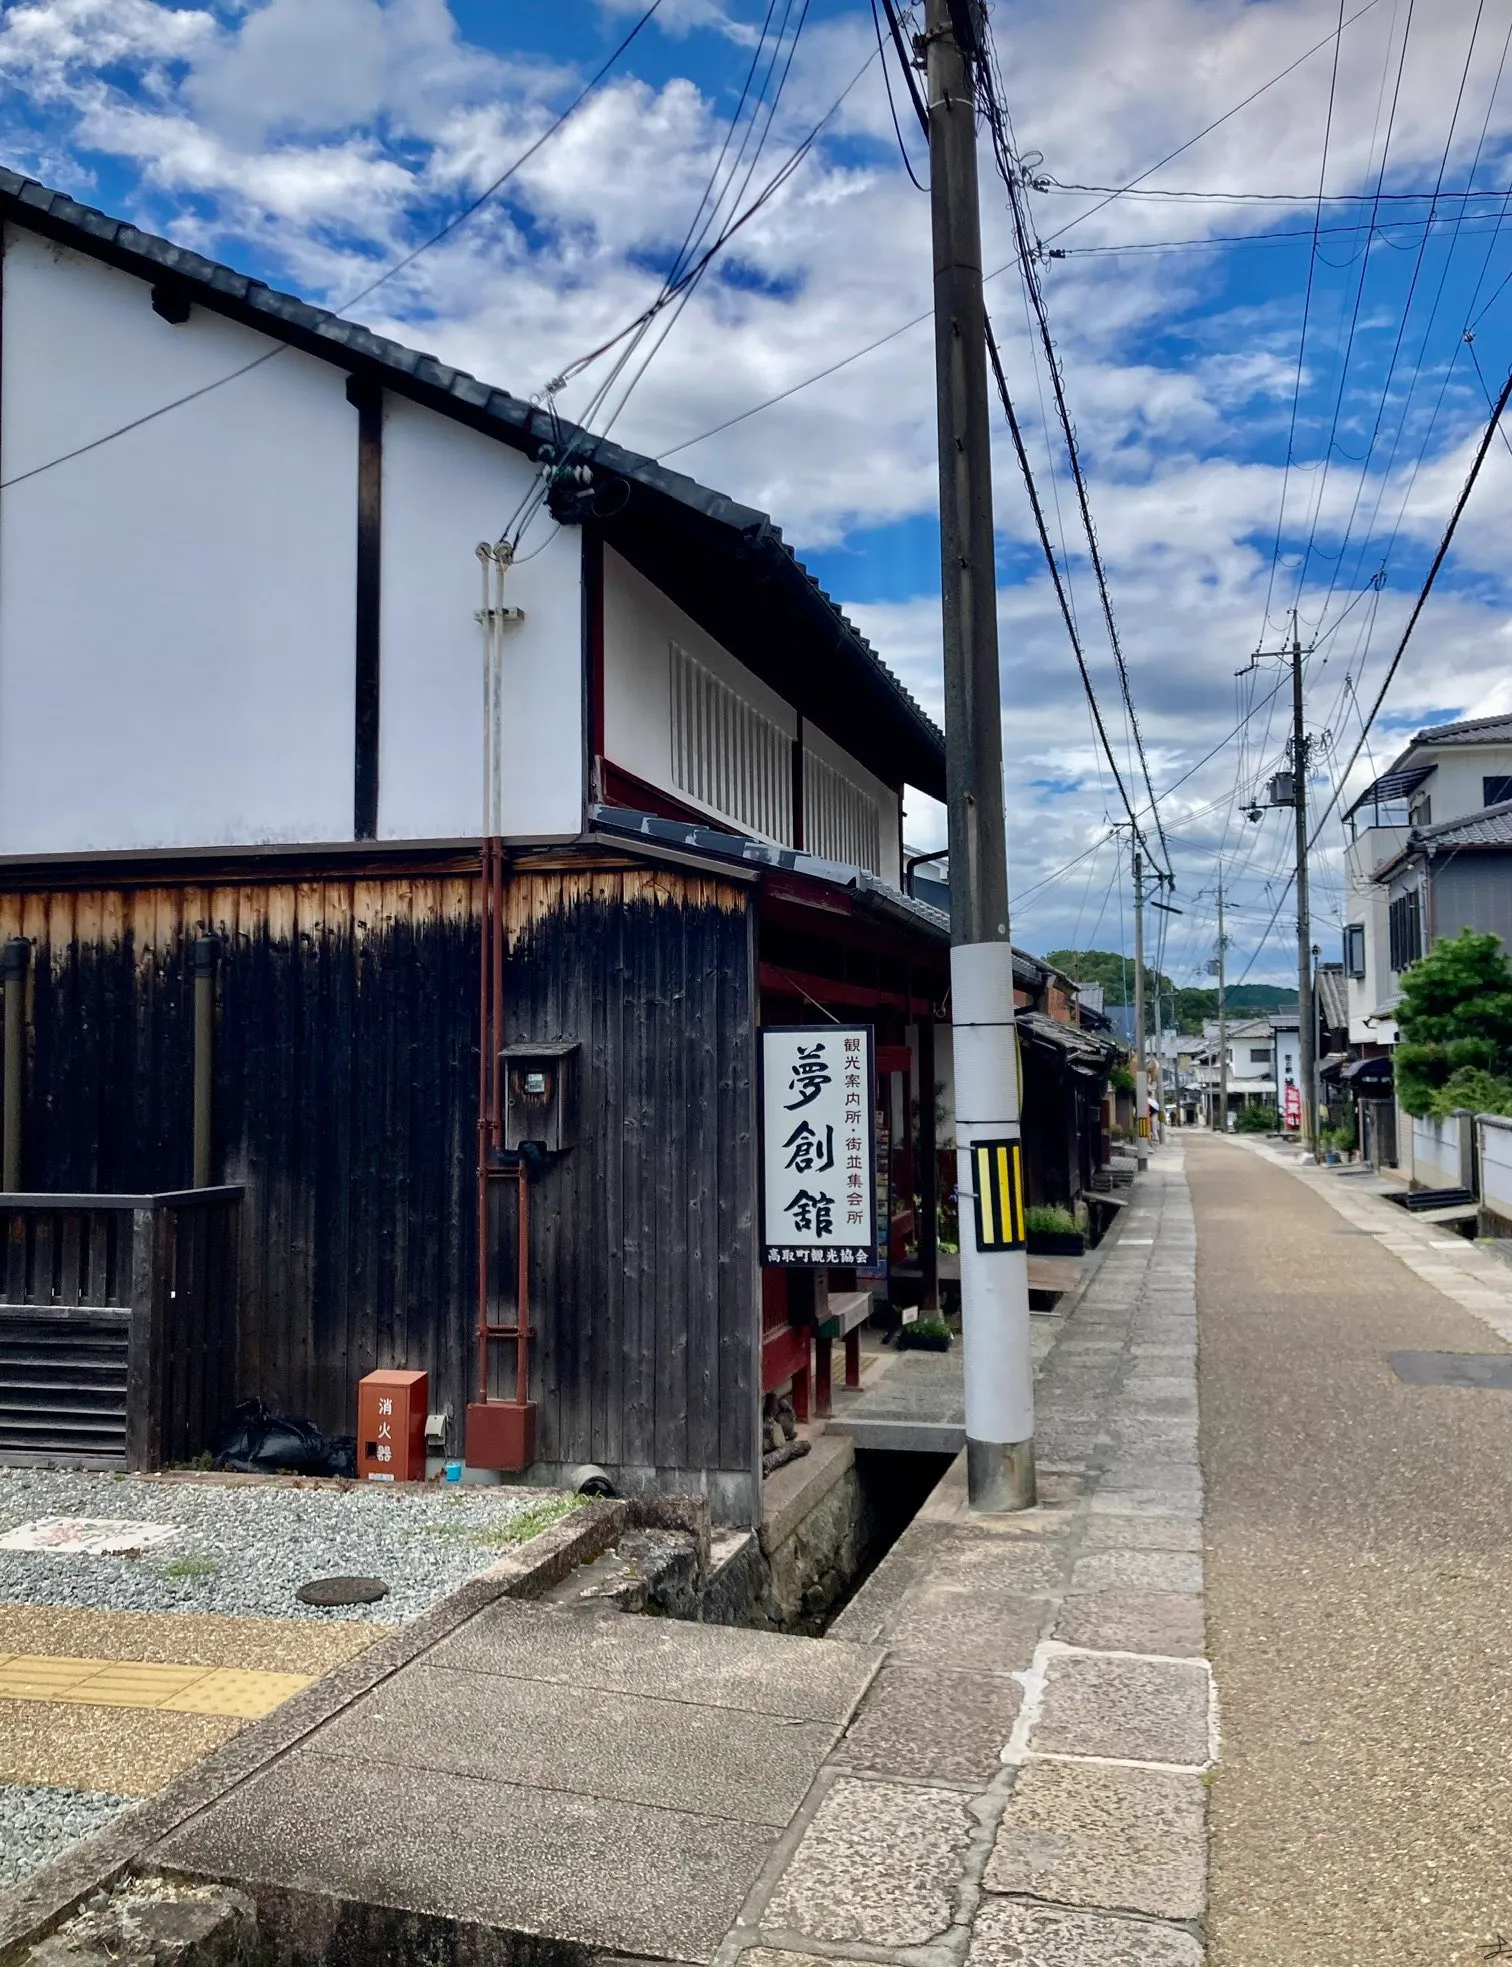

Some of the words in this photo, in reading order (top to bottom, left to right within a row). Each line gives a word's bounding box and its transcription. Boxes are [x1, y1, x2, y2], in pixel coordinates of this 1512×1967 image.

[844, 1038, 863, 1224] 観光案内所・街並集会所
[767, 1248, 869, 1264] 高取町観光協会
[377, 1397, 392, 1462] 消火器
